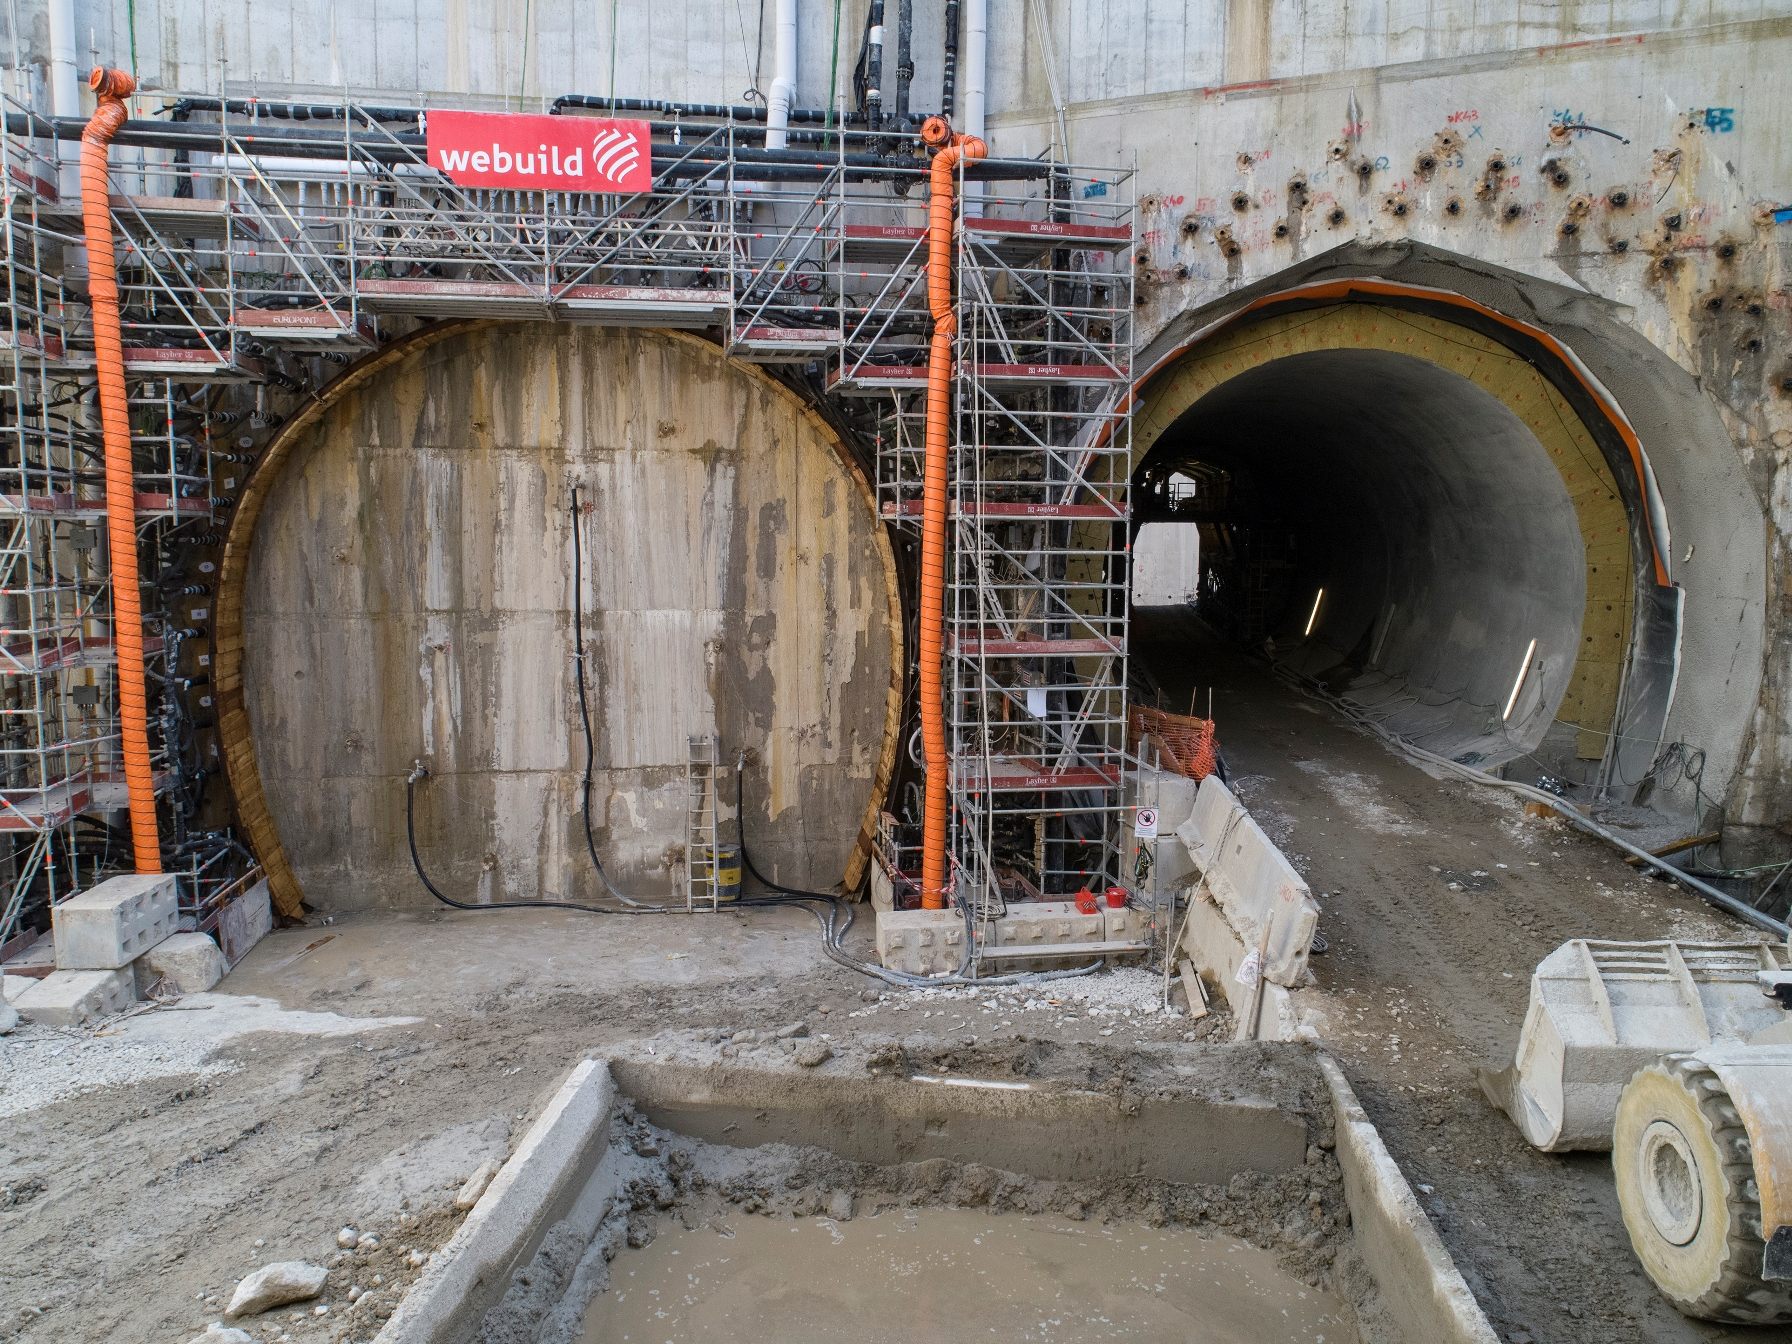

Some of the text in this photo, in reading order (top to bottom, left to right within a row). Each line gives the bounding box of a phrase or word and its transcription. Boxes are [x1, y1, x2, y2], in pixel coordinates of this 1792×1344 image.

[440, 143, 583, 177] webuild
[882, 227, 905, 236] Layher
[1039, 225, 1063, 234] Layher
[273, 315, 317, 324] EUROPONT
[156, 351, 183, 360] Layher
[882, 368, 905, 376] Layher
[1037, 367, 1060, 375] Layher
[1037, 506, 1059, 514] Layher
[1026, 777, 1049, 785] Layher
